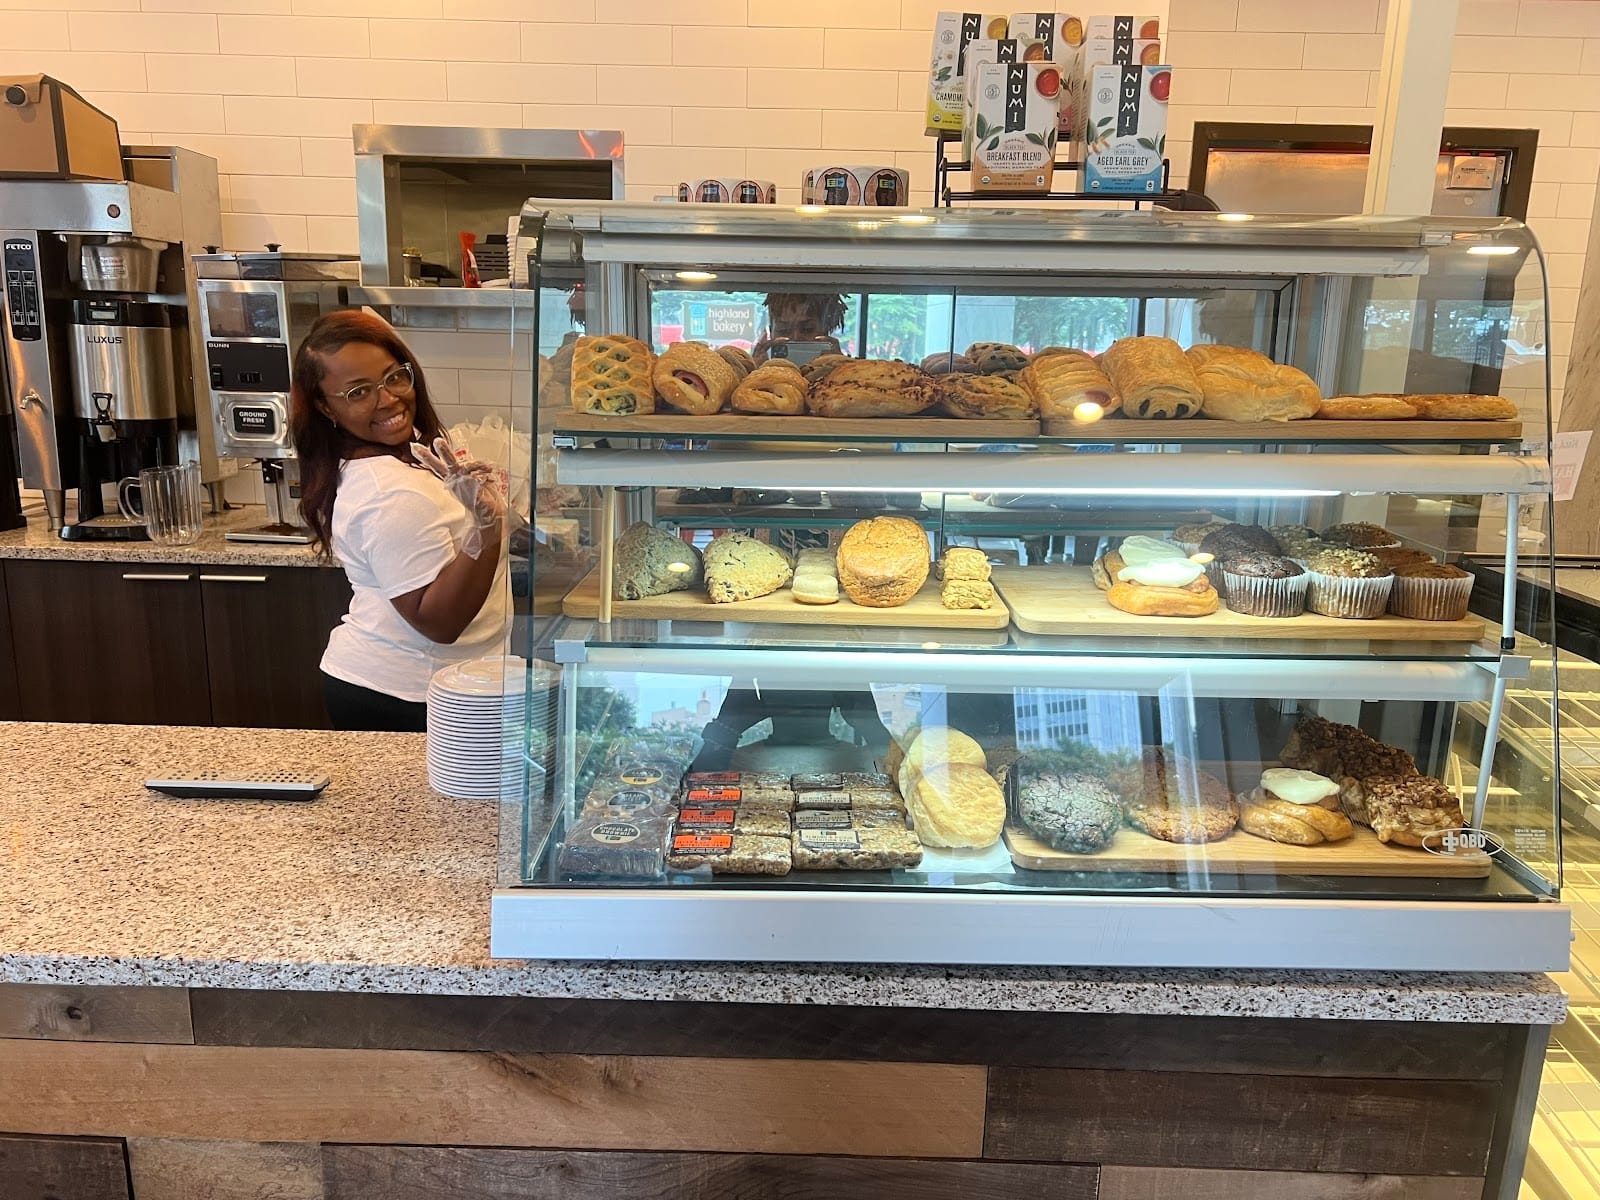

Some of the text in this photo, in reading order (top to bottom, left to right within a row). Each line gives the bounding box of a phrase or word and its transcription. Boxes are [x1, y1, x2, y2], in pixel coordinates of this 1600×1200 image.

[1008, 69, 1024, 123] NUMI
[1121, 72, 1139, 127] NUMI
[986, 151, 1042, 161] BREAKFAST BLEND
[1097, 156, 1149, 166] AGED EARL GREY
[708, 307, 750, 320] highland
[712, 319, 746, 335] bakery
[87, 335, 123, 344] LUXUS
